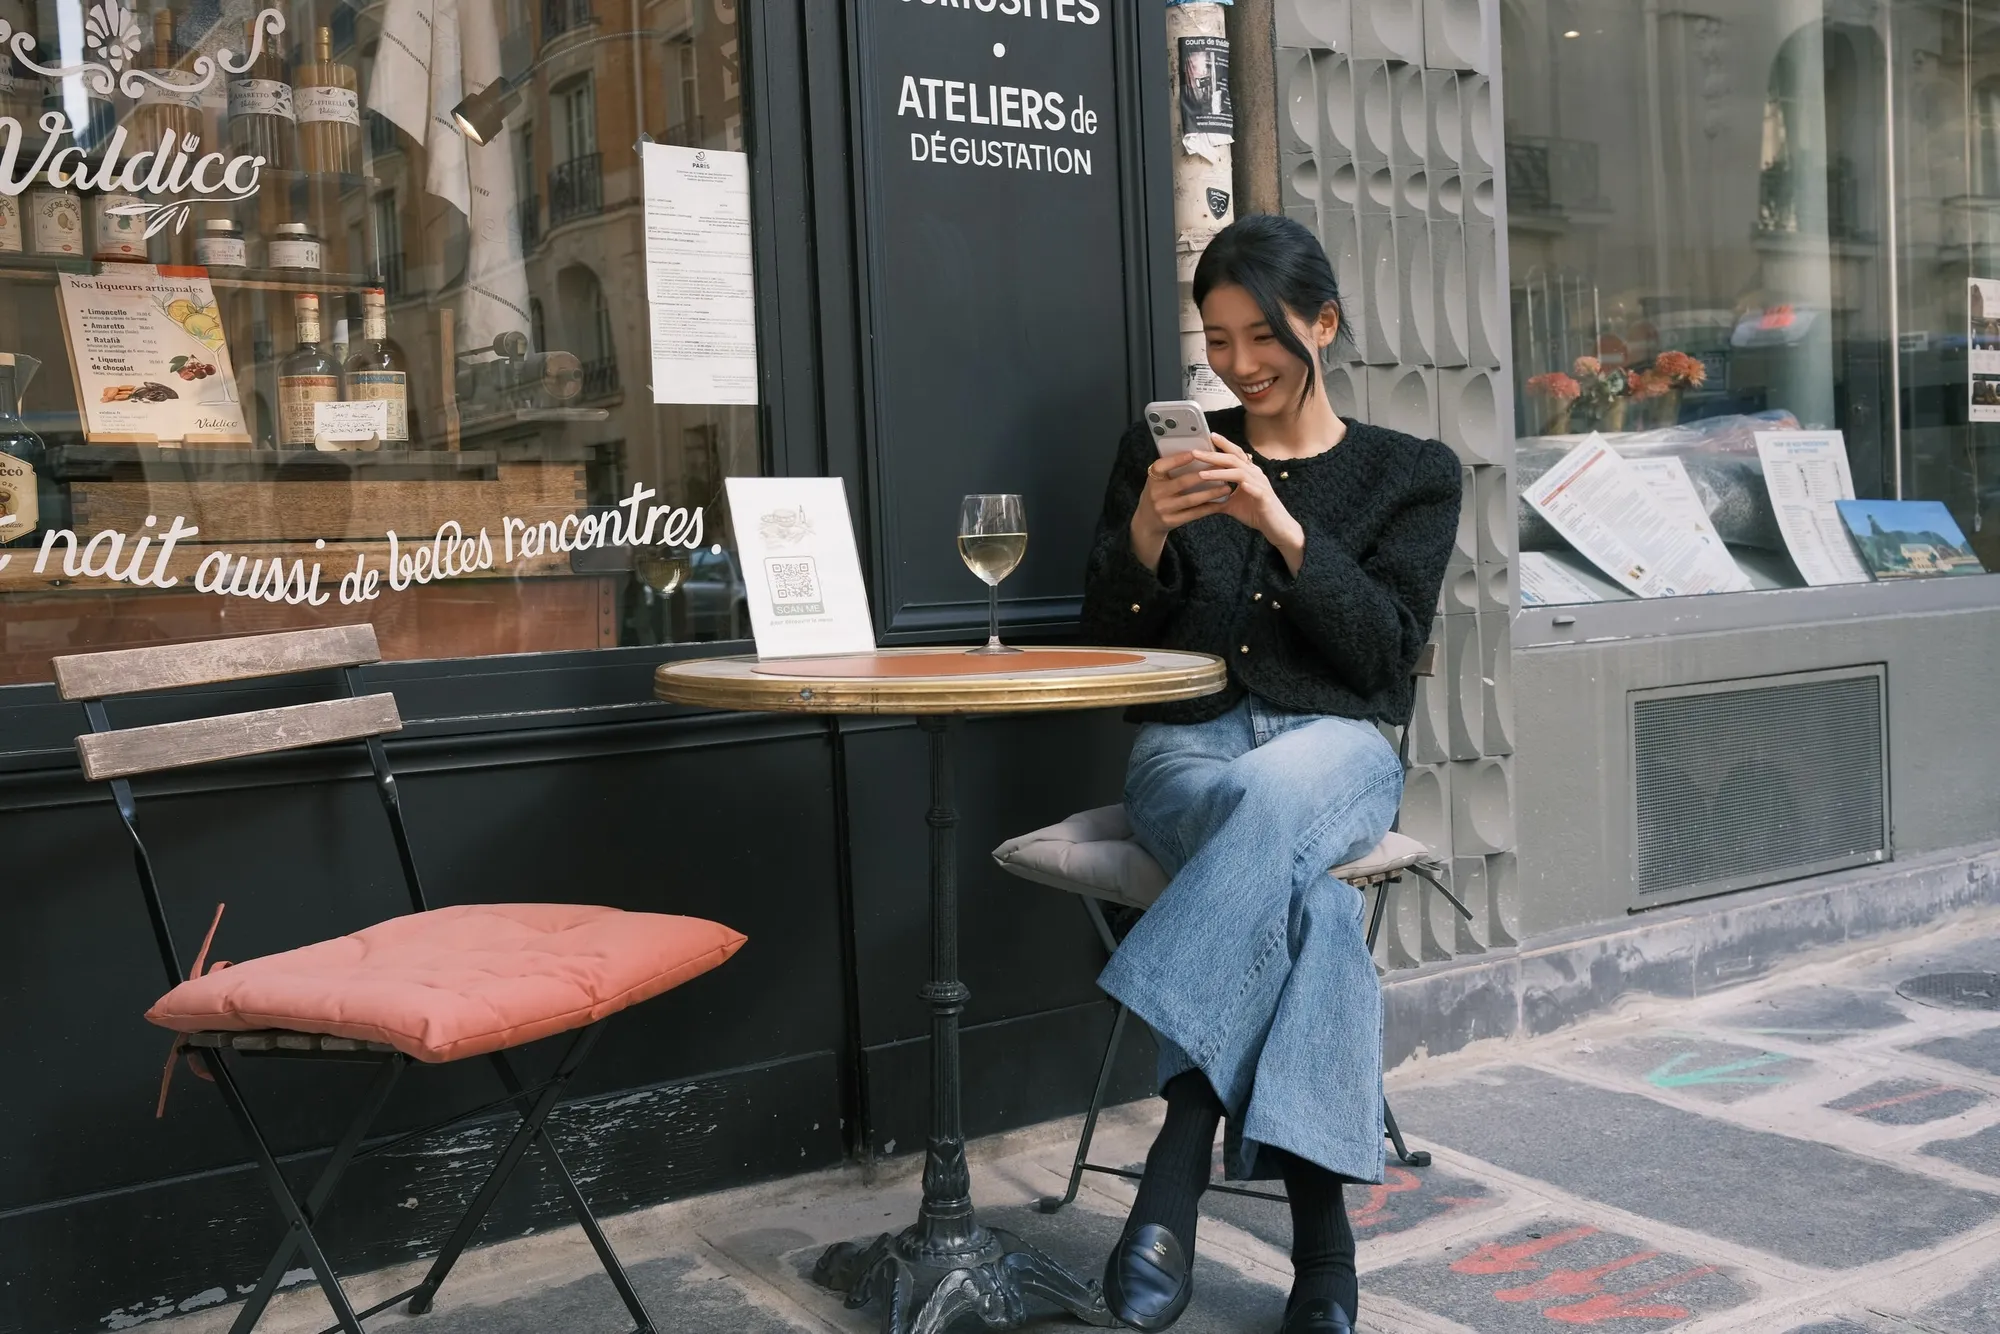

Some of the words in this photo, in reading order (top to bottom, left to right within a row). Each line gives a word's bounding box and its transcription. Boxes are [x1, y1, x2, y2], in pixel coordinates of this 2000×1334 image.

[233, 92, 269, 100] AMARETTO
[897, 75, 1066, 131] ATELIERS
[1070, 94, 1098, 135] de
[0, 111, 266, 196] Valdico
[910, 130, 1092, 175] DÉGUSTATION
[71, 280, 93, 290] Nos
[95, 281, 143, 293] liqueurs
[145, 284, 204, 294] artisanales
[88, 308, 128, 316] Limoncello
[91, 322, 125, 330] Amaretto
[93, 336, 120, 344] Ratafià
[97, 356, 126, 364] Liqueur
[102, 364, 134, 372] chocolat
[195, 418, 238, 429] Valdico
[0, 466, 23, 477] ccò
[33, 515, 199, 589] nait
[194, 538, 330, 606] aussi
[339, 553, 380, 605] de
[386, 520, 493, 592] belles
[502, 481, 722, 563] rencontres.
[776, 605, 804, 615] SCAN
[806, 604, 821, 613] ME
